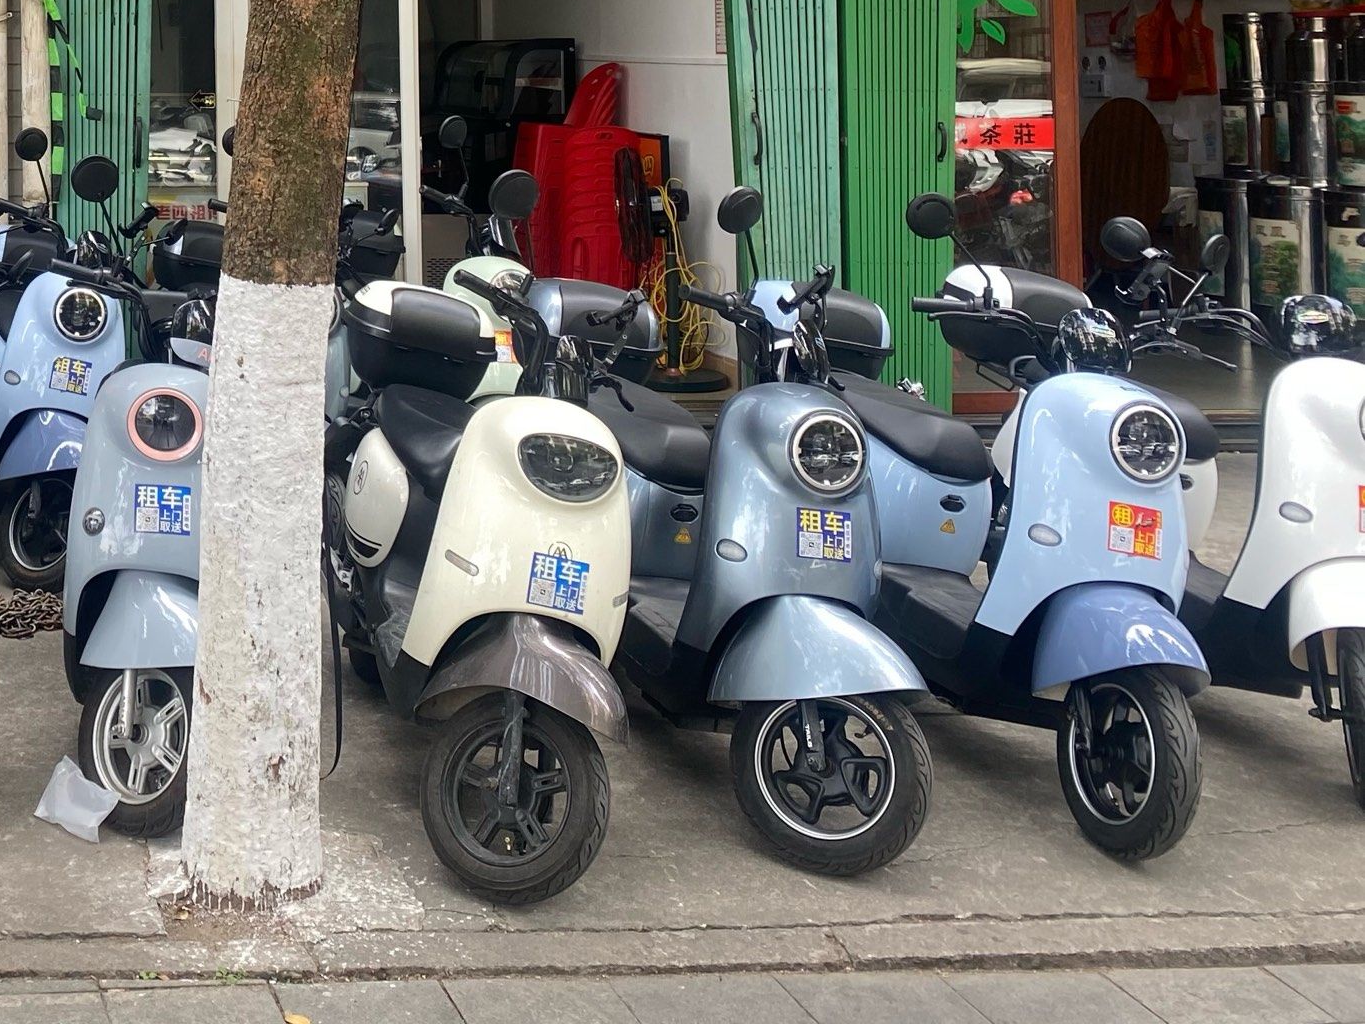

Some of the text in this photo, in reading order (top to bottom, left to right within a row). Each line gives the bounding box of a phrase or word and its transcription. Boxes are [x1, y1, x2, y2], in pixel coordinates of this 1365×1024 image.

[954, 122, 1036, 145] 茶莊
[55, 359, 86, 376] 租车
[138, 486, 182, 509] 租车
[160, 509, 182, 522] 上门
[800, 509, 844, 535] 租车
[824, 535, 844, 548] 上门
[534, 555, 581, 585] 租车
[556, 584, 579, 599] 上门
